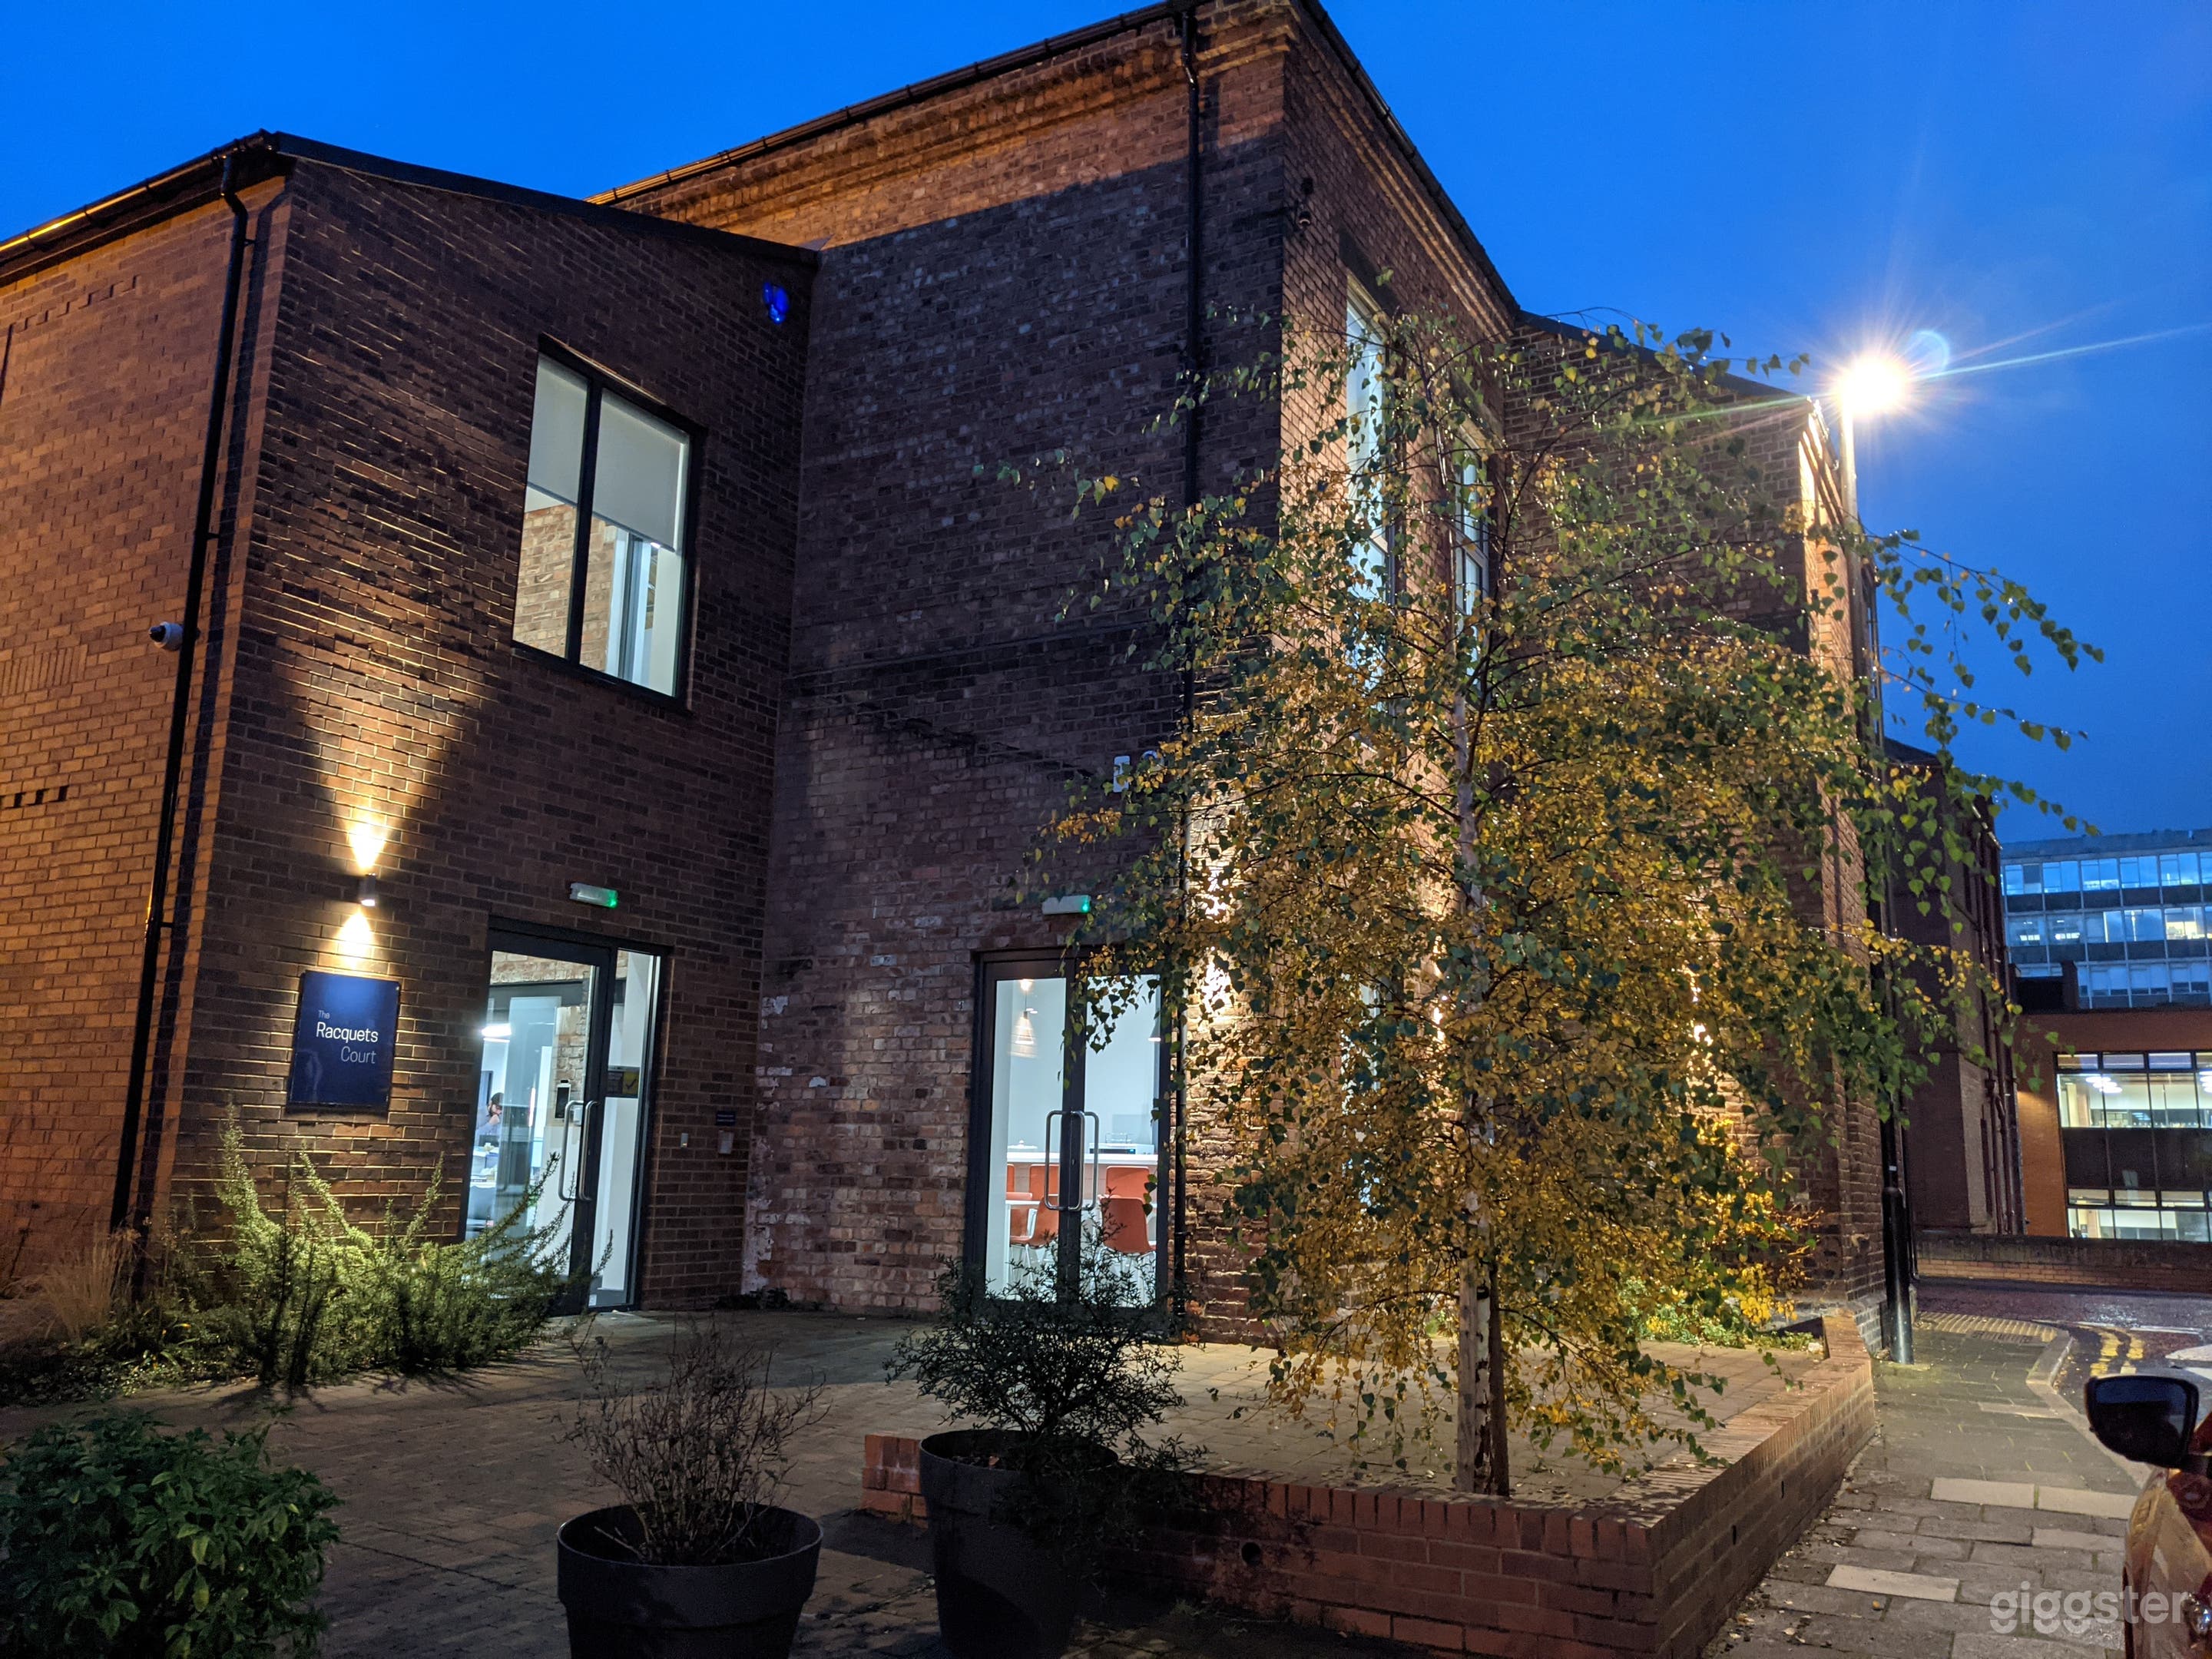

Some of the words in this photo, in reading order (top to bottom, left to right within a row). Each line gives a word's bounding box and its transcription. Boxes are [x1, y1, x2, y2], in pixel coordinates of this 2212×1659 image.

[318, 1010, 330, 1019] The
[316, 1022, 379, 1043] Racquets
[341, 1045, 376, 1064] Court
